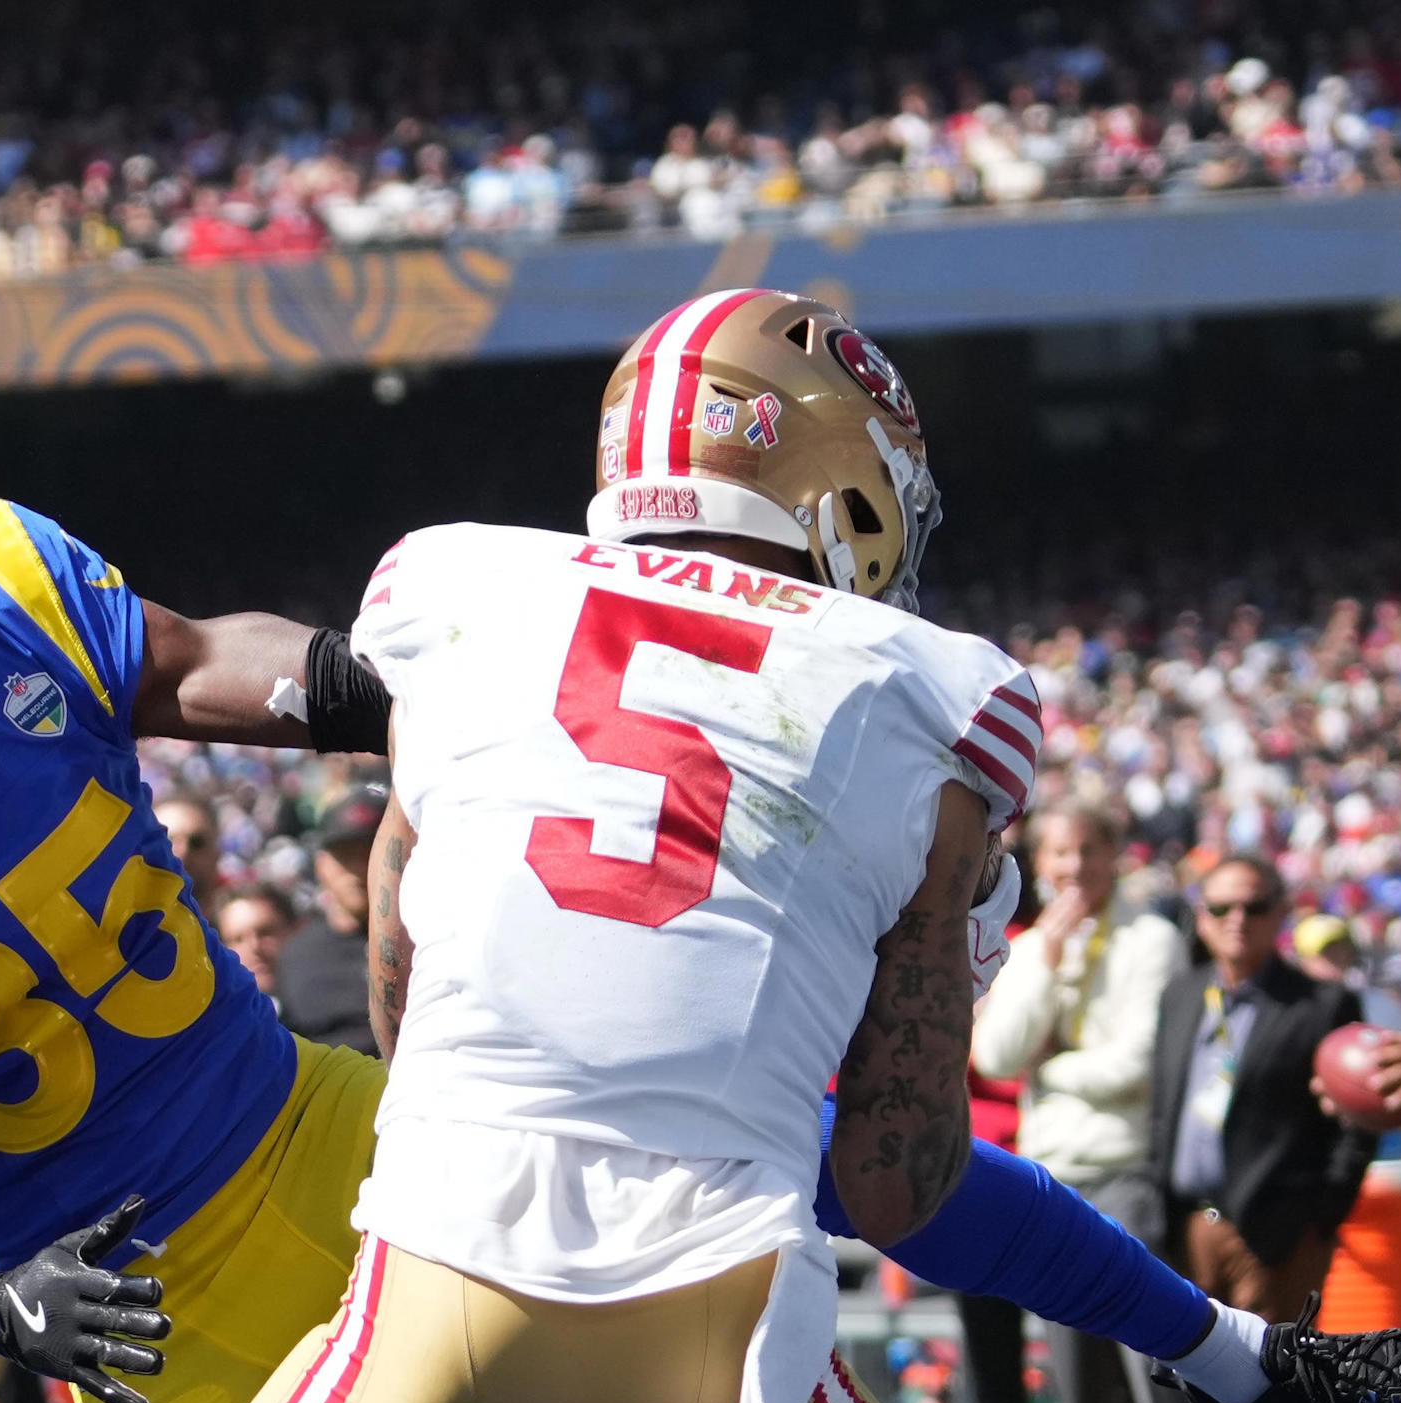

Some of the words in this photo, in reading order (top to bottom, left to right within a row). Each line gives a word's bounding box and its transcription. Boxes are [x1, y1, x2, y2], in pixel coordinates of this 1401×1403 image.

[706, 414, 731, 432] NFL
[615, 485, 698, 521] 49ERS
[570, 541, 824, 617] EVANS
[18, 687, 58, 726] MELBOURNE
[524, 586, 774, 928] 5
